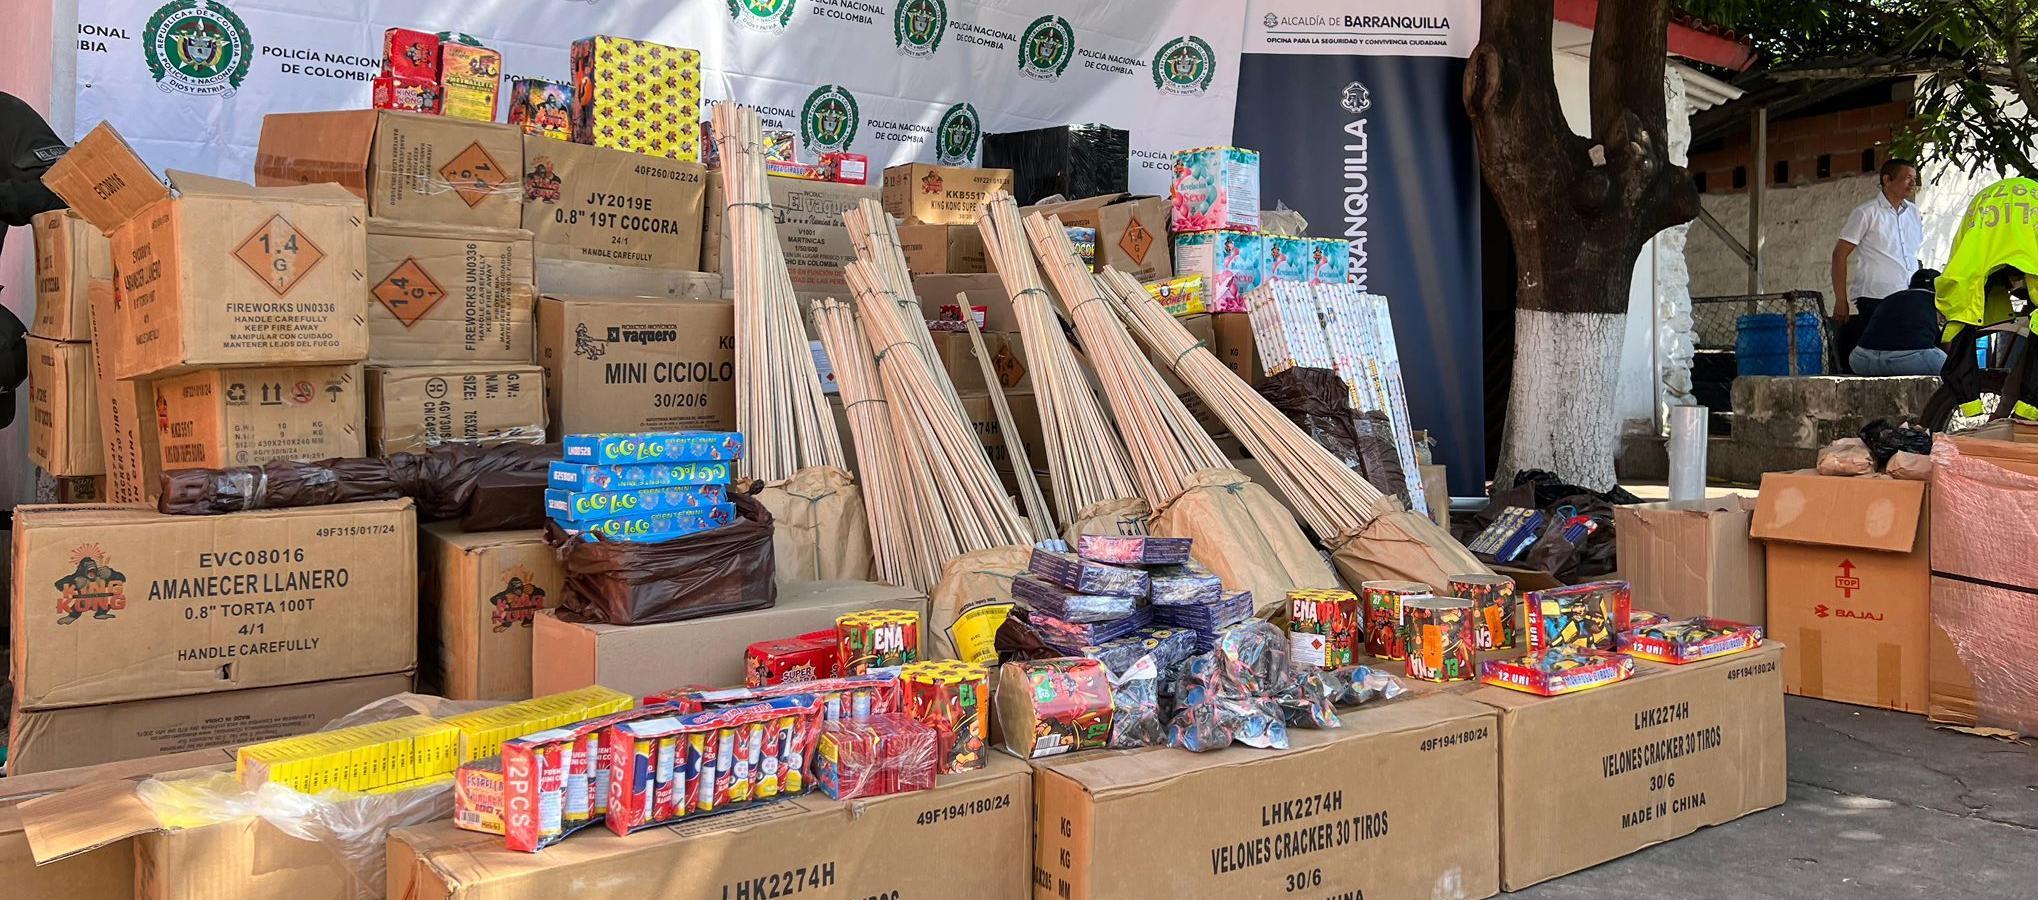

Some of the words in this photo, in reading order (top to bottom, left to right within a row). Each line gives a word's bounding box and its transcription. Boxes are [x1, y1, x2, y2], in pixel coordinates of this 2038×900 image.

[813, 7, 825, 16] DE
[827, 9, 873, 25] COLOMBIA
[1281, 14, 1326, 26] ALCALDÍA
[1329, 16, 1341, 26] DE
[1344, 16, 1450, 29] BARRANQUILLA
[157, 11, 189, 49] REPUBLICA
[196, 9, 208, 17] DE
[216, 16, 240, 58] COLOMBIA
[964, 35, 1004, 50] COLOMBIA
[973, 26, 1017, 42] NACIONAL
[262, 45, 320, 63] POLICÍA
[1078, 48, 1107, 61] POLICÍA
[1108, 54, 1148, 68] NACIONAL
[197, 62, 236, 85] NACIONAL
[281, 62, 299, 74] DE
[1084, 60, 1095, 69] DE
[1096, 63, 1134, 76] COLOMBIA
[169, 79, 189, 92] DIOS
[197, 84, 225, 94] PATRIA
[867, 120, 898, 131] POLICÍA
[898, 123, 935, 134] NACIONAL
[875, 131, 886, 140] DE
[887, 133, 924, 144] COLOMBIA
[1131, 149, 1167, 161] POLICÍA
[1142, 160, 1154, 170] DE
[587, 192, 653, 211] JY2019E
[946, 190, 986, 200] KKB5517
[556, 208, 585, 226] 0.8"
[590, 212, 617, 229] 19T
[620, 214, 679, 236] COCORA
[259, 233, 299, 256] 1.4
[611, 236, 629, 246] 24/1
[787, 236, 825, 245] MARTINICAS
[466, 243, 478, 283] UN0336
[582, 247, 612, 258] HANDLE
[613, 249, 653, 262] CAREFULLY
[273, 257, 288, 272] G
[388, 276, 410, 308] 1.4
[411, 287, 424, 299] G
[226, 302, 293, 313] FIREWORKS
[296, 302, 335, 312] UN0336
[275, 315, 328, 323] CAREFULLY
[465, 287, 477, 351] FIREWORKS
[622, 330, 677, 346] vaquero
[605, 363, 647, 384] MINI
[654, 361, 733, 383] CICIOLO
[464, 375, 477, 401] SIZE:
[654, 393, 708, 408] 30/20/6
[112, 398, 121, 435] TIROS
[128, 429, 138, 479] CHINA
[316, 525, 396, 539] 49F315/017/24
[199, 548, 305, 569] EVC08016
[62, 581, 125, 598] KING
[148, 574, 258, 601] AMANECER
[263, 568, 349, 593] LLANERO
[1838, 579, 1857, 587] TOP
[56, 596, 127, 615] KONG
[185, 605, 217, 621] 0.8"
[221, 601, 276, 618] TORTA
[279, 598, 315, 614] 100T
[1835, 608, 1884, 621] BAJAJ
[238, 623, 265, 636] 4/1
[177, 645, 236, 662] HANDLE
[239, 637, 320, 657] CAREFULLY
[1633, 642, 1644, 653] 12
[1646, 644, 1663, 655] UNI
[783, 669, 812, 682] SUPER
[1498, 671, 1509, 681] 12
[1512, 673, 1529, 685] UNI
[1728, 661, 1776, 681] 49F194/180/24
[960, 684, 976, 707] EL
[1634, 701, 1689, 731] LHK2274H
[1420, 726, 1489, 753] 49F194/180/24
[1602, 746, 1643, 779] VELONES
[1644, 735, 1684, 767] CRACKER
[1685, 733, 1696, 755] 30
[1697, 725, 1721, 752] TIROS
[1650, 772, 1675, 792] 30/6
[916, 793, 1011, 827] 49F194/180/24
[1262, 790, 1343, 827] LHK2274H
[1622, 806, 1652, 829] MADE
[1656, 801, 1667, 818] IN
[1672, 792, 1706, 814] CHINA
[1060, 816, 1072, 838] KG
[1211, 837, 1271, 875] VELONES
[1274, 823, 1333, 862] CRACKER
[1336, 819, 1350, 846] 30
[1353, 810, 1389, 842] TIROS
[1060, 848, 1071, 869] KG
[1285, 868, 1322, 893] 30/6
